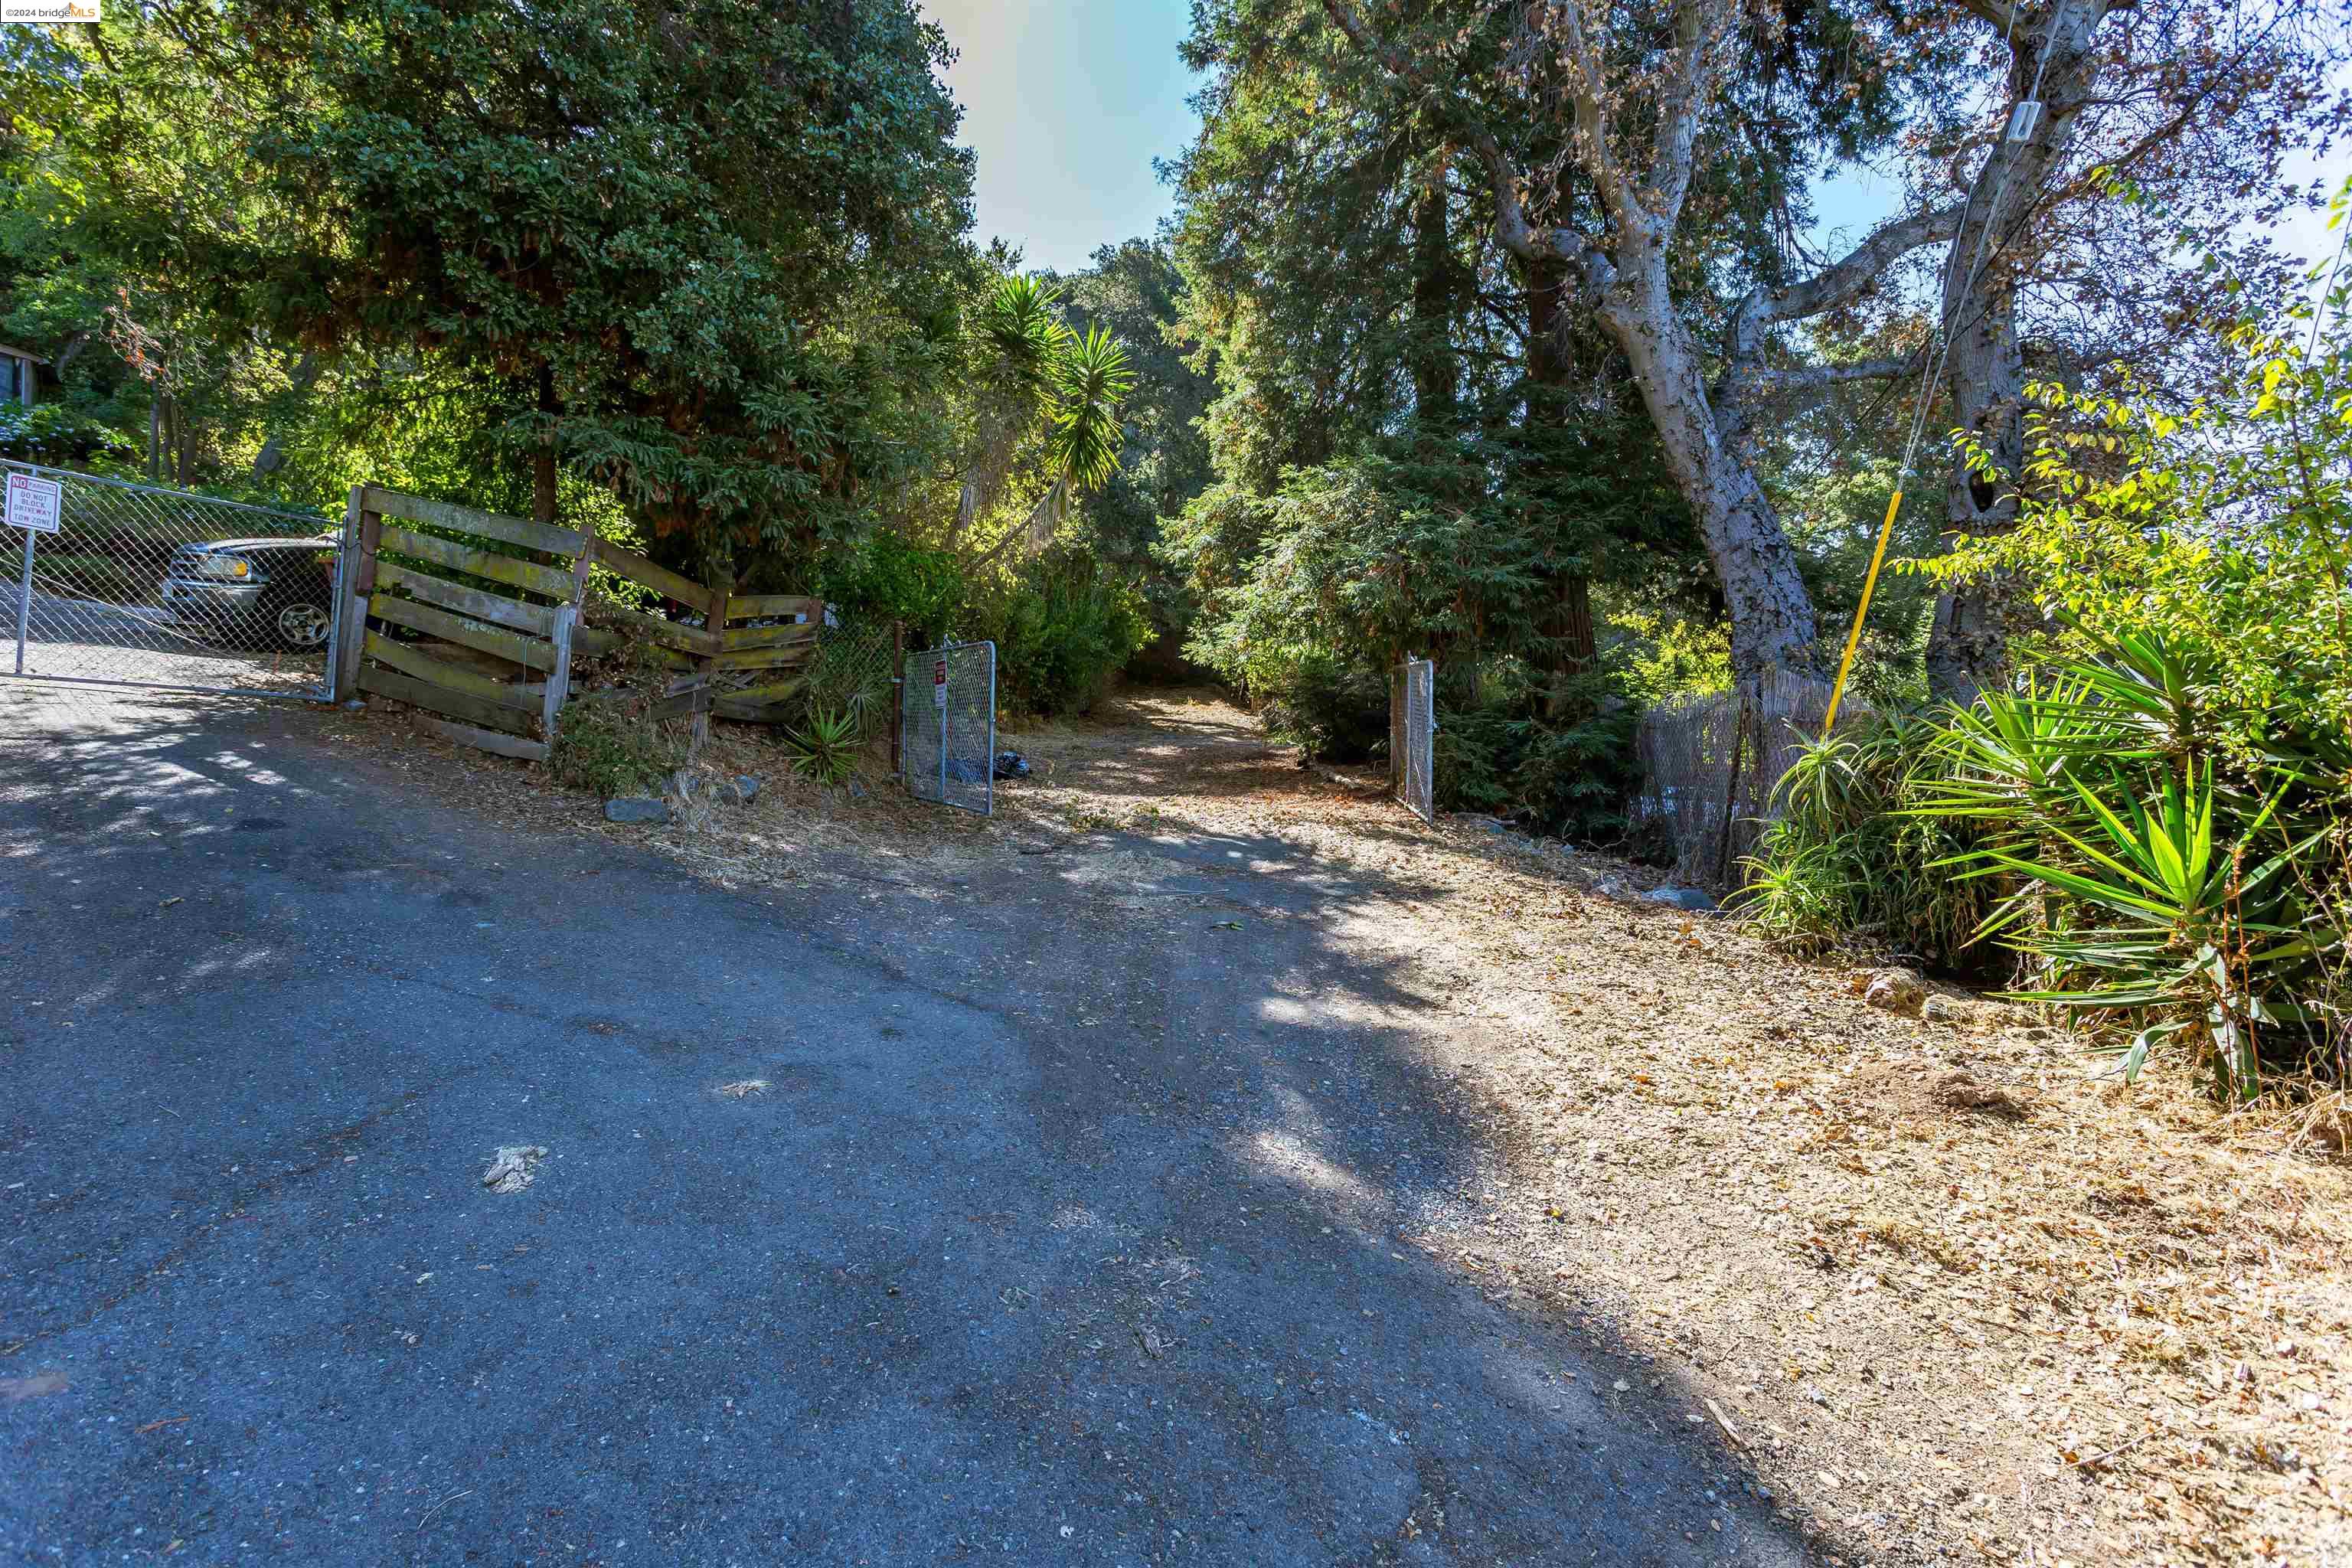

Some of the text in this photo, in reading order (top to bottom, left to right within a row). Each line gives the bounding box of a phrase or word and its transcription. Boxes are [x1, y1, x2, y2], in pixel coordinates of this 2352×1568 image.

[12, 477, 27, 488] NO
[21, 490, 47, 502] DO NOT
[21, 498, 46, 508] BLOCK
[14, 504, 52, 516] DRIVEWAY
[31, 517, 50, 526] ZONE
